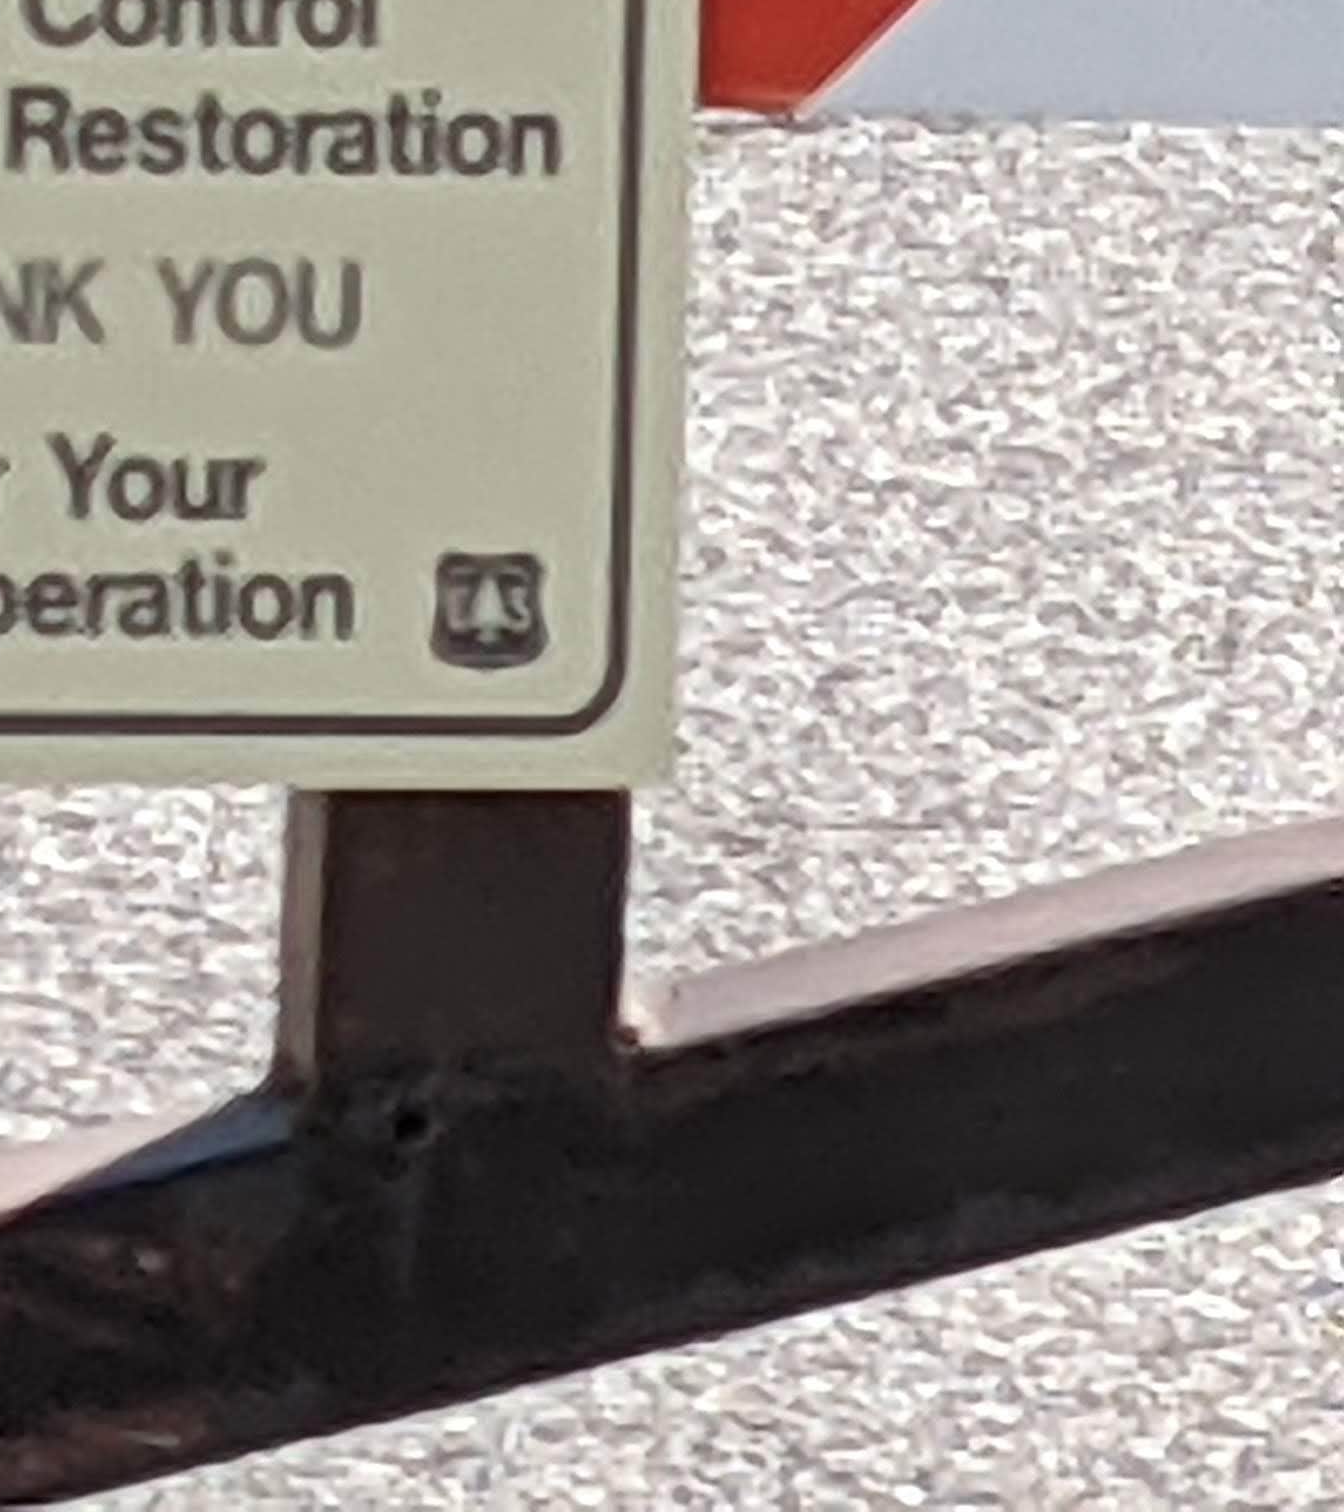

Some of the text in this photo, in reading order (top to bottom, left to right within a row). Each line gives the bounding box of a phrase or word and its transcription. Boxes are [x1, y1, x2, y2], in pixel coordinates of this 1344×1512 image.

[5, 85, 561, 177] Restoration
[156, 256, 362, 350] YOU
[47, 432, 266, 522] Your
